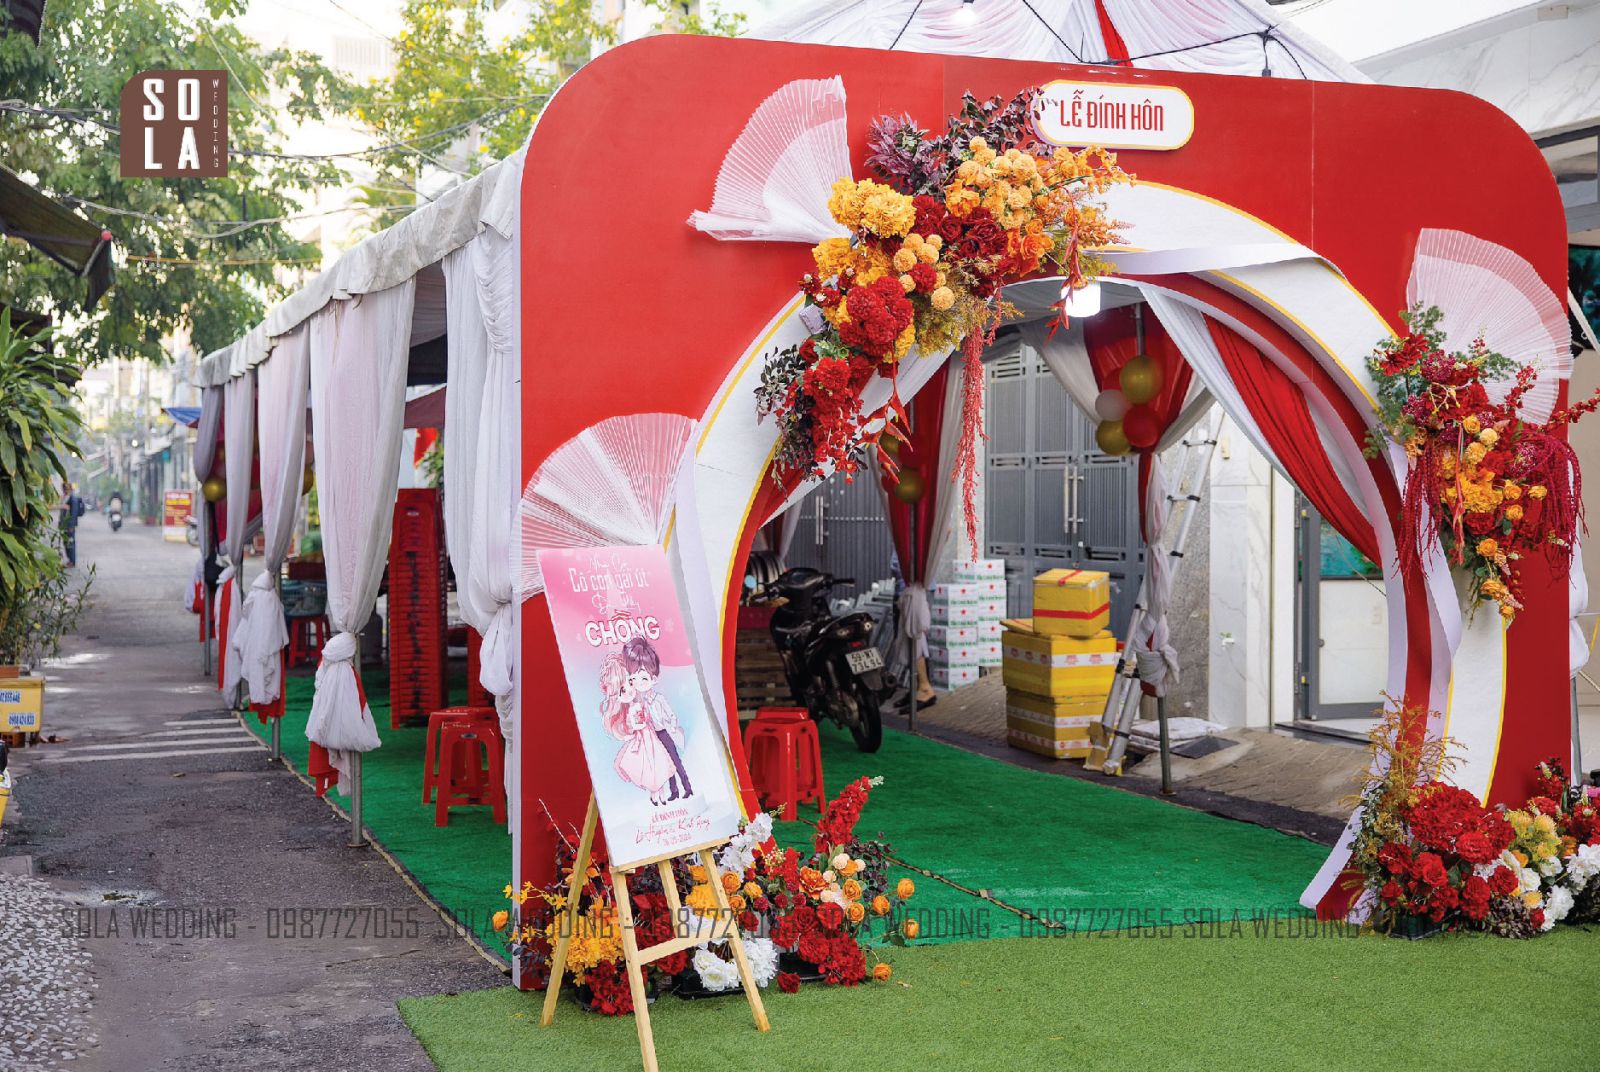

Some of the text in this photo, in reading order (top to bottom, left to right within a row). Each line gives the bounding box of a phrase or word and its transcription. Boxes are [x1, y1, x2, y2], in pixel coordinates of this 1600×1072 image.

[1060, 89, 1164, 131] LỄ ĐÍNH HÔN
[585, 609, 660, 647] CHỒNG
